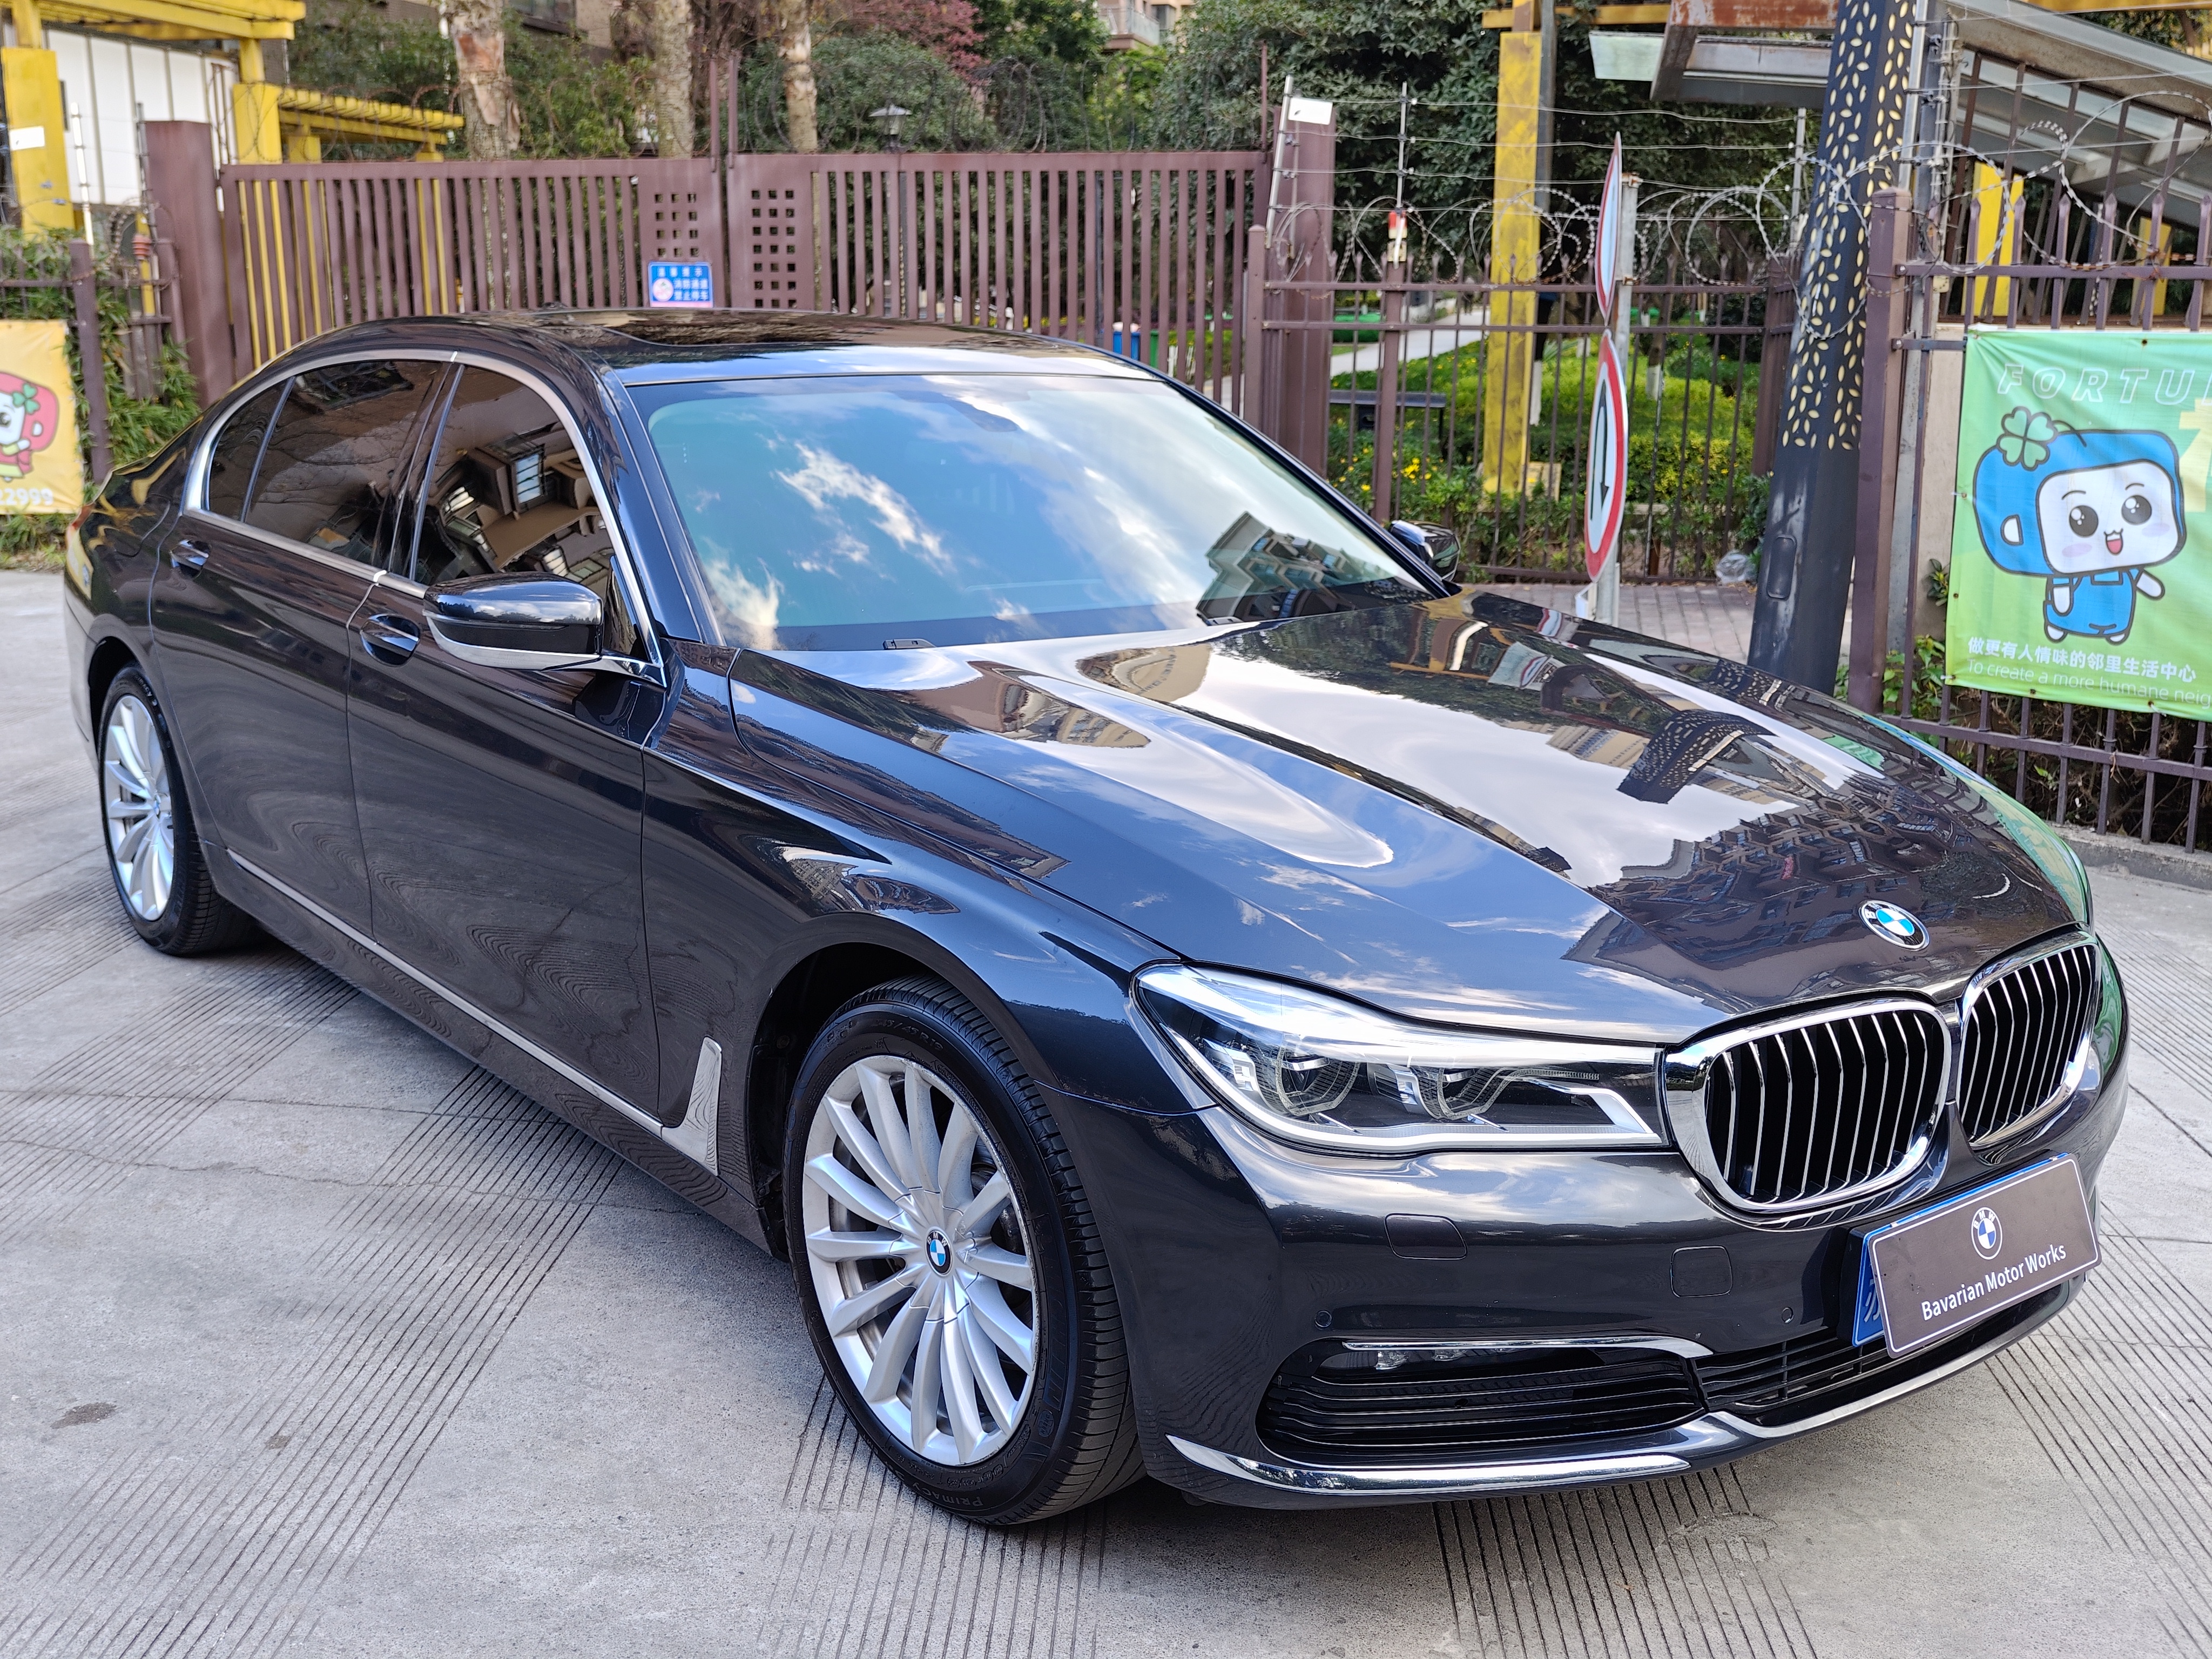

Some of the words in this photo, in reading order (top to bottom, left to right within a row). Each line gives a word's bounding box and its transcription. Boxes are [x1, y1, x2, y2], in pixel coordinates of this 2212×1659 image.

[1997, 363, 2212, 406] FORTU
[1967, 658, 1983, 675] To
[1987, 664, 2034, 682] create
[2038, 672, 2048, 684] a
[2053, 674, 2094, 690] more
[2100, 677, 2169, 700] humane
[1968, 637, 2196, 683] 做更有人情味的邻里生活中心
[927, 1232, 948, 1246] BMW
[1973, 1210, 1996, 1229] BMW
[1921, 1281, 1985, 1321] Bavarian
[1985, 1260, 2025, 1293] Motor
[2024, 1244, 2067, 1274] Works
[913, 1482, 983, 1506] PRIMACY
